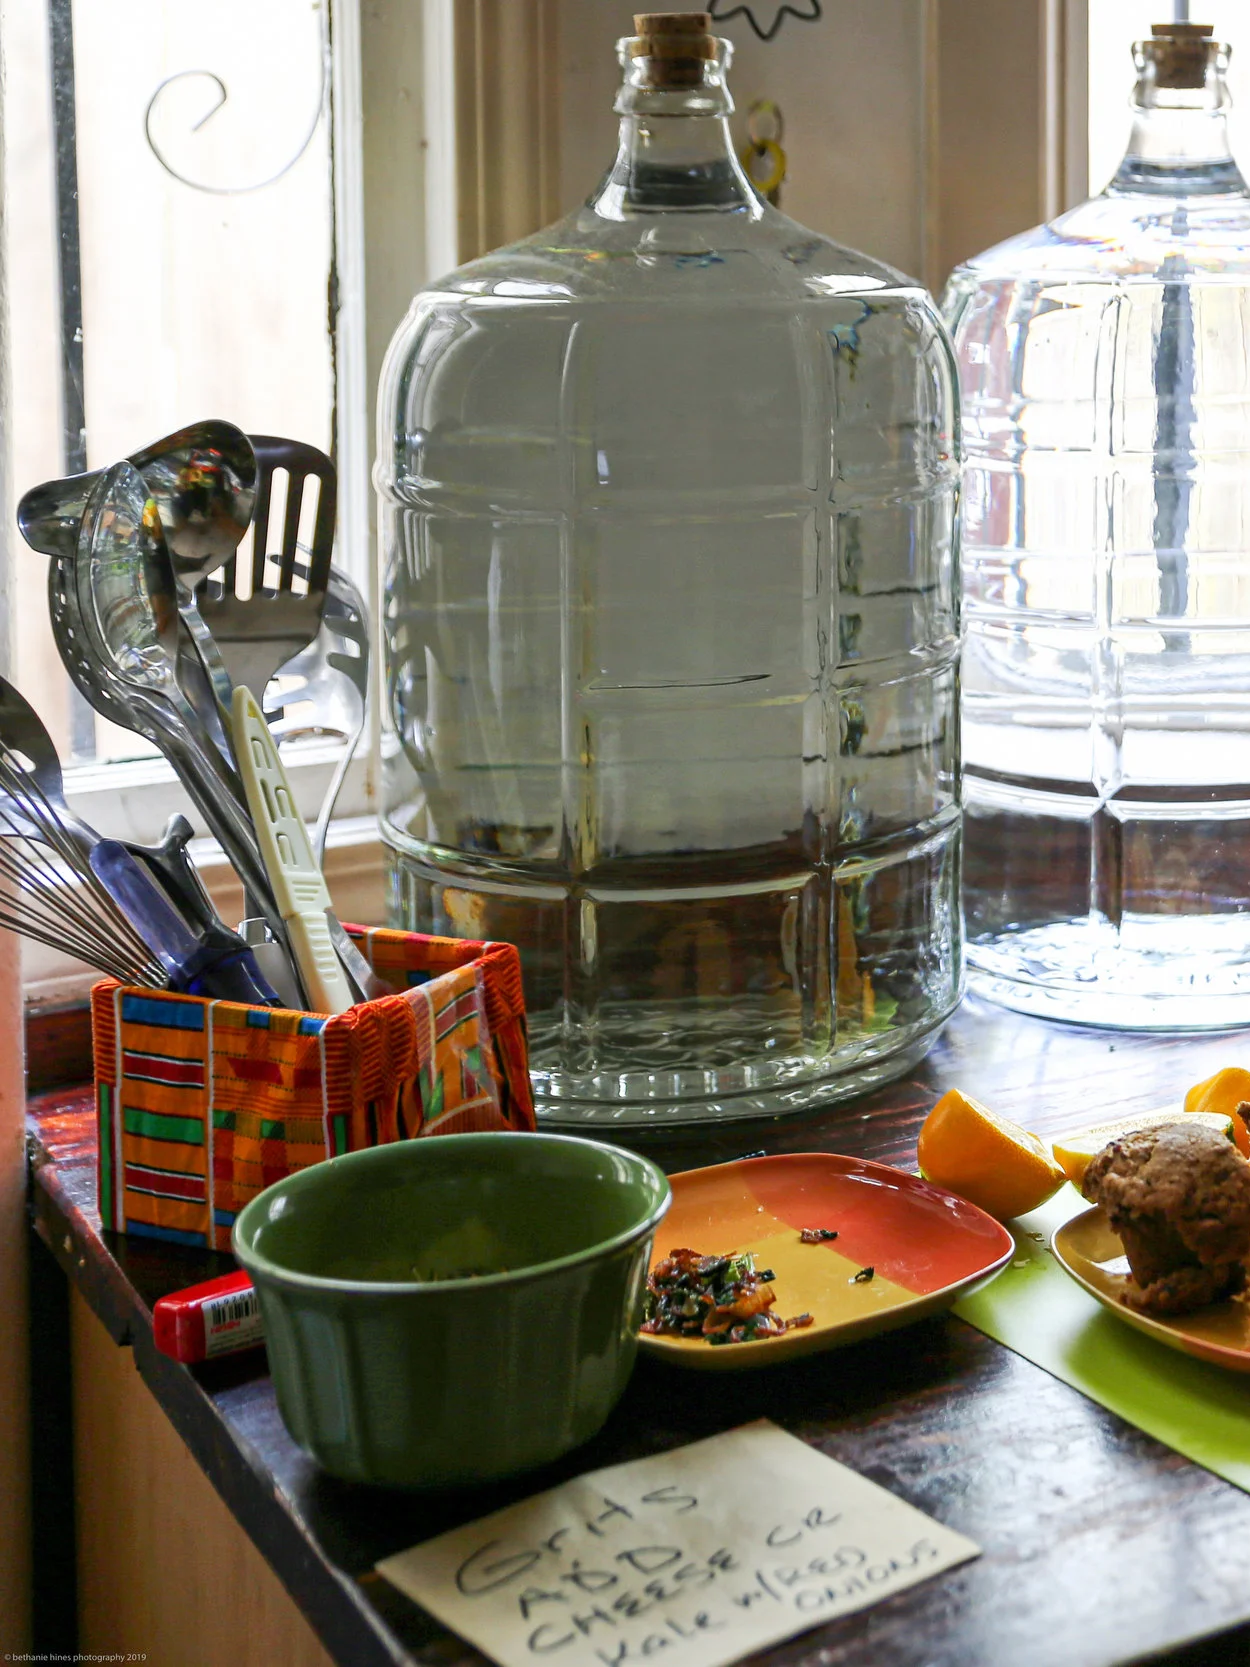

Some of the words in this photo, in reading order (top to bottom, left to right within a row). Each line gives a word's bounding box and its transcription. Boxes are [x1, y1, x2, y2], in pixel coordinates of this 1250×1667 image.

[519, 1545, 683, 1622] ADD
[527, 1547, 741, 1653] CHEESE
[794, 1537, 939, 1612] ONIONS
